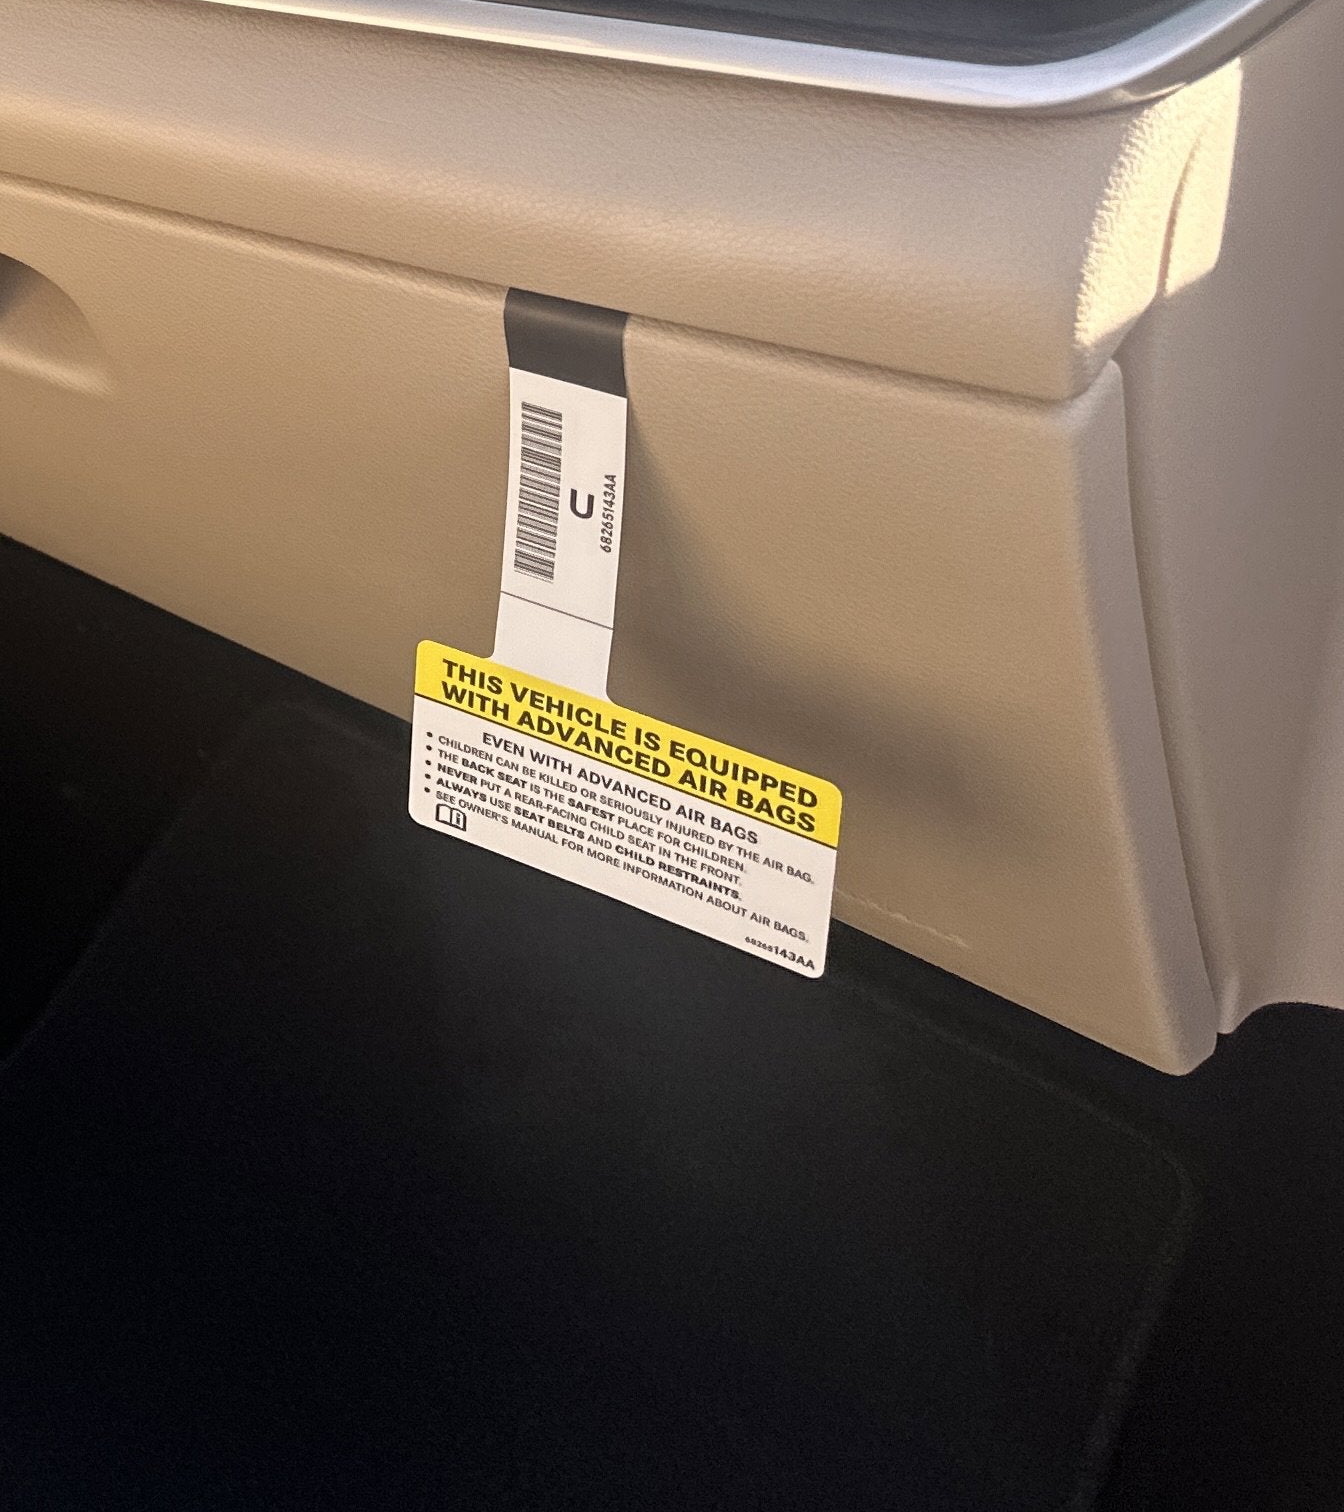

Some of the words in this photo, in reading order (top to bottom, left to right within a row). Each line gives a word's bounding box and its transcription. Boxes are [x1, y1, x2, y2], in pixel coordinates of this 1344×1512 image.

[570, 488, 595, 519] U
[599, 474, 617, 554] 68265143AA
[440, 680, 509, 721] WITH
[516, 707, 671, 780] ADVANCED
[676, 766, 728, 801] AIR
[735, 788, 816, 833] BAGS
[441, 658, 503, 696] THIS
[508, 682, 627, 741] VEHICLE
[634, 727, 661, 753] IS
[668, 739, 819, 810] EQUIPPED
[482, 731, 525, 758] EVEN
[528, 748, 572, 776] WITH
[576, 766, 672, 813] ADVANCED
[675, 803, 705, 826] AIR
[710, 816, 758, 846] BAGS
[435, 775, 487, 804] ALWAYS
[489, 795, 511, 813] USE
[513, 804, 545, 825] SEAT
[547, 817, 585, 840] BELTS
[586, 832, 612, 851] AND
[614, 843, 655, 868] CHILD
[436, 761, 478, 786] NEVER
[480, 777, 501, 795] PUT
[503, 786, 512, 798] A
[514, 790, 587, 827] REAR-FACING
[589, 819, 625, 841] CHILD
[627, 833, 656, 853] SEAT
[657, 845, 671, 859] IN
[673, 851, 698, 869] THE
[437, 747, 459, 765] THE
[461, 756, 495, 778] BACK
[496, 770, 527, 790] SEAT
[529, 782, 541, 795] IS
[542, 787, 565, 804] THE
[567, 796, 615, 823] SAFEST
[617, 815, 654, 838] PLACE
[656, 830, 681, 848] FOR
[437, 733, 493, 763] CHILDREN
[495, 755, 519, 773] CAN
[521, 765, 536, 779] BE
[538, 771, 578, 795] KILLED
[579, 787, 597, 802] OR
[599, 794, 663, 827] SERIOUSLY
[665, 819, 715, 847] INJURED
[717, 839, 734, 854] BY
[735, 845, 760, 864] THE
[762, 856, 784, 873] AIR
[435, 788, 456, 806] SEE
[457, 797, 509, 826] OWNER'S
[511, 818, 559, 845] MANUAL
[561, 837, 584, 854] FOR
[586, 847, 620, 869] MORE
[622, 861, 703, 901] INFORMATION
[705, 894, 747, 919] ABOUT
[749, 911, 771, 928] AIR
